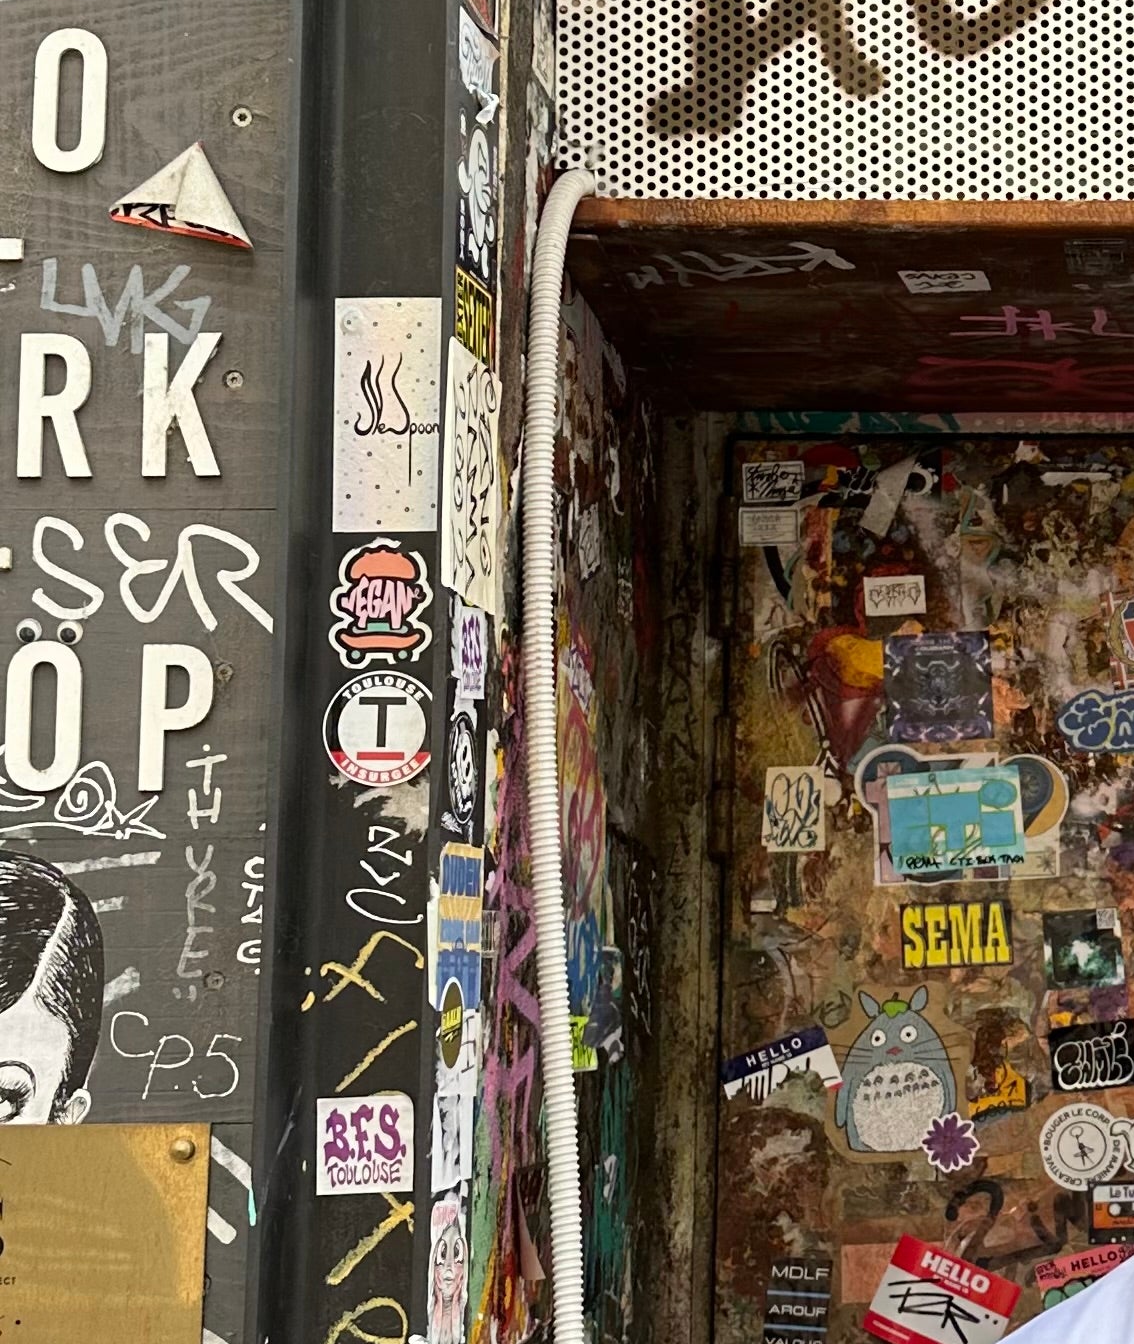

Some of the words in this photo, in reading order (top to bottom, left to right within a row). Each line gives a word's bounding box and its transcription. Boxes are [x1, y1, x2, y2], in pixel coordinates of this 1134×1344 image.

[341, 573, 422, 629] VEGAN
[341, 674, 424, 703] TOULOUSE
[903, 902, 1012, 967] SEMA
[746, 1036, 803, 1068] HELLO
[1043, 1112, 1070, 1146] BOUGER
[1085, 1108, 1111, 1125] CORP
[327, 1160, 403, 1188] TOULOUSE
[771, 1264, 830, 1281] MDLF
[920, 1249, 991, 1294] HELLO
[1070, 1250, 1120, 1272] HELLO
[768, 1304, 827, 1318] AROUF
